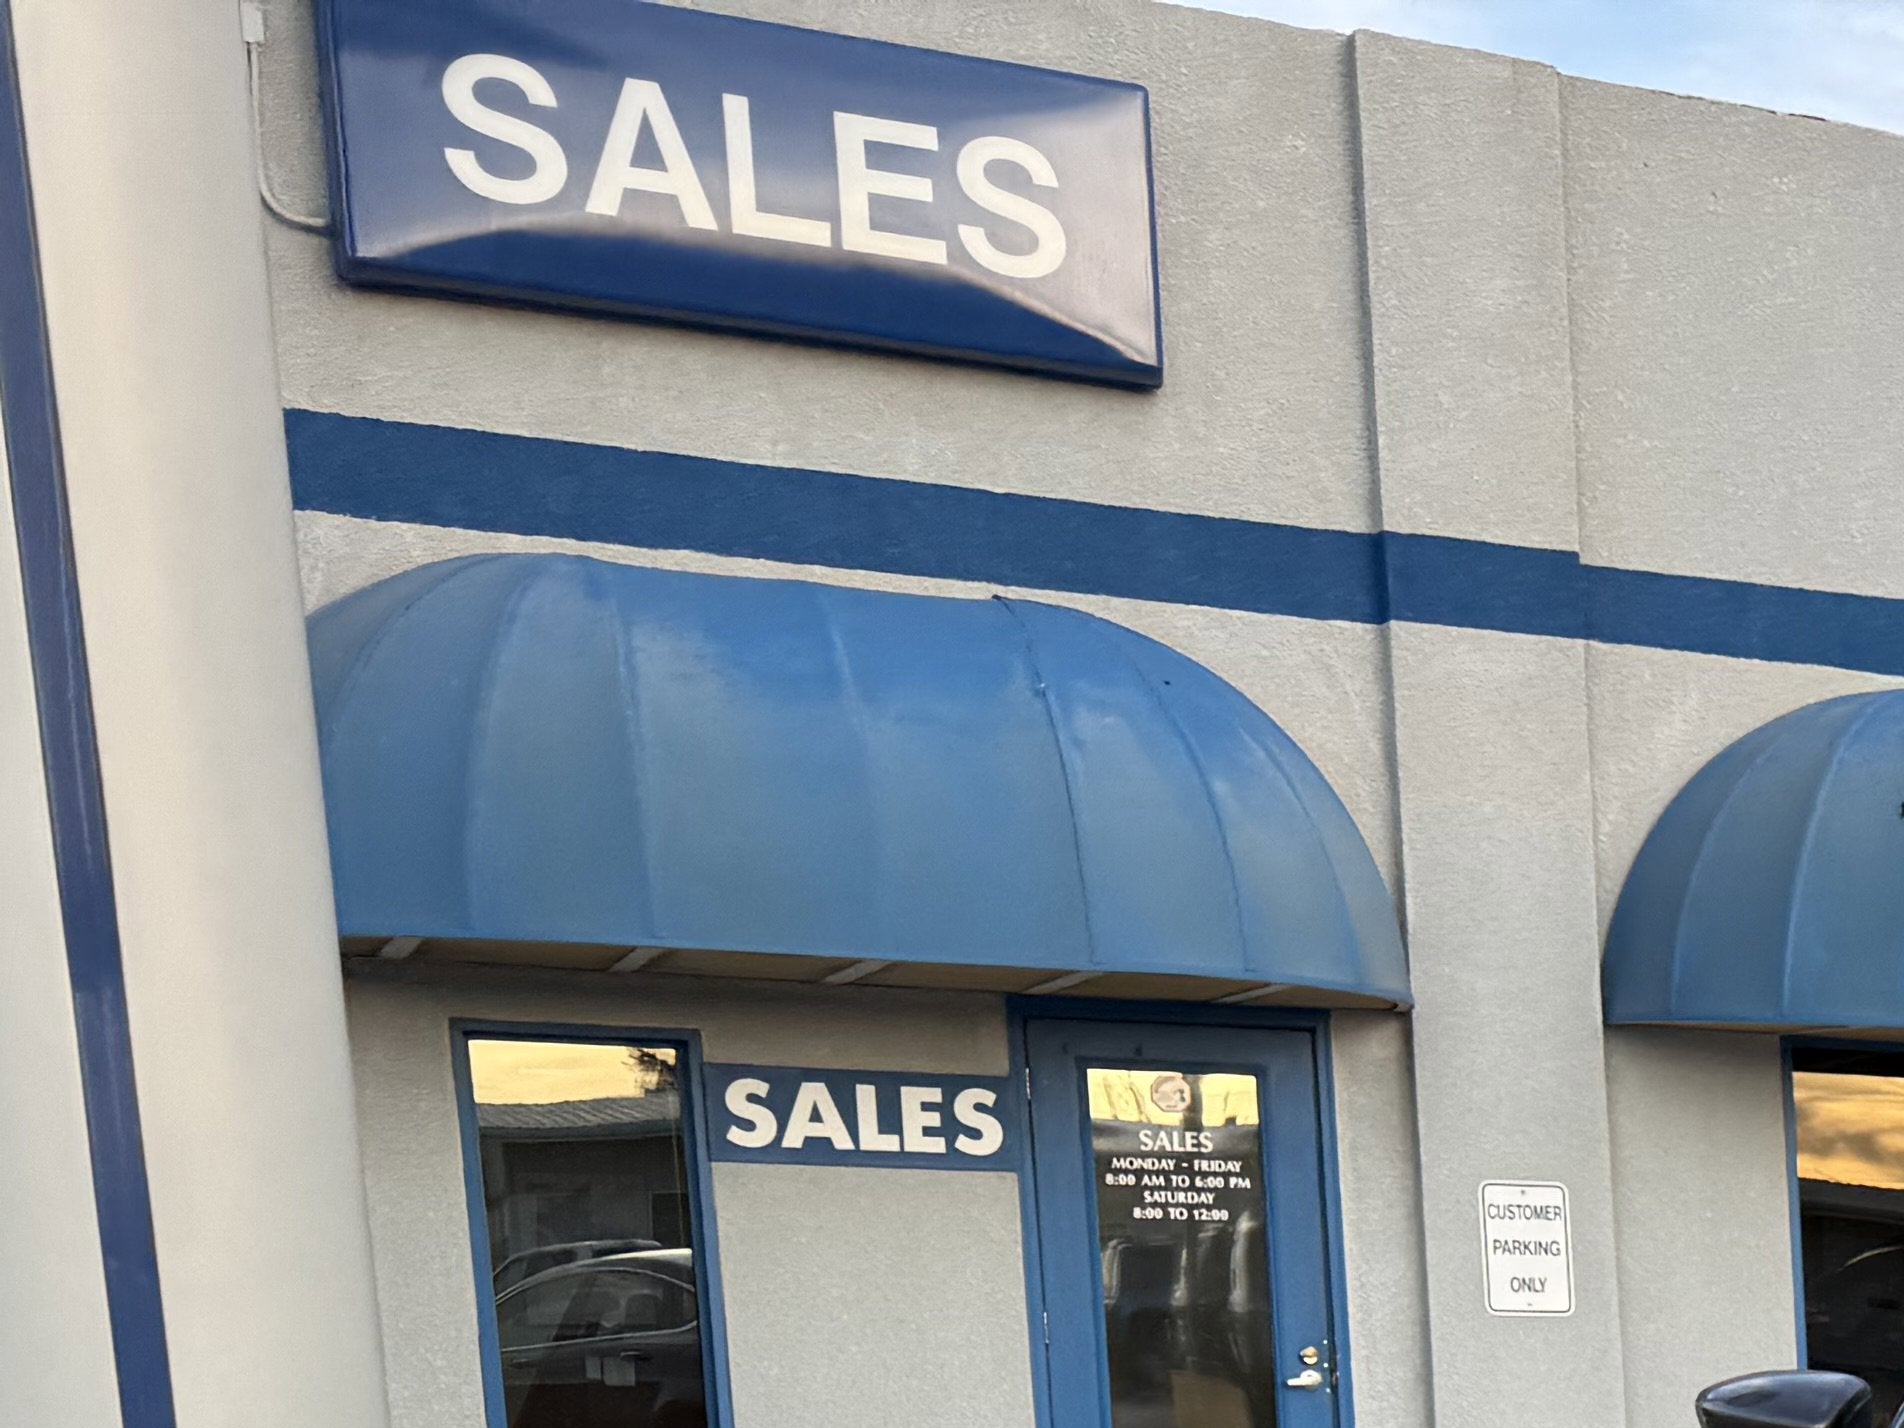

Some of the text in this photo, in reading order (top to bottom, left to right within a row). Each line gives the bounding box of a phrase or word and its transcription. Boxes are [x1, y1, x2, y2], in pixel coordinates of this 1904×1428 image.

[441, 53, 1067, 279] SALES
[724, 1077, 1004, 1157] SALES
[1138, 1129, 1214, 1153] SALES
[1111, 1156, 1176, 1171] MONDAY
[1193, 1158, 1243, 1173] FRIDAY
[1105, 1173, 1136, 1186] 8:00
[1141, 1175, 1166, 1187] AM
[1170, 1175, 1190, 1188] TO
[1229, 1177, 1252, 1189] PM
[1143, 1190, 1216, 1205] SATURDAY
[1132, 1207, 1229, 1222] 8:00 TO 12:00
[1487, 1203, 1563, 1221] CUSTOMER
[1492, 1238, 1562, 1257] PARKING
[1510, 1276, 1548, 1293] ONLY
